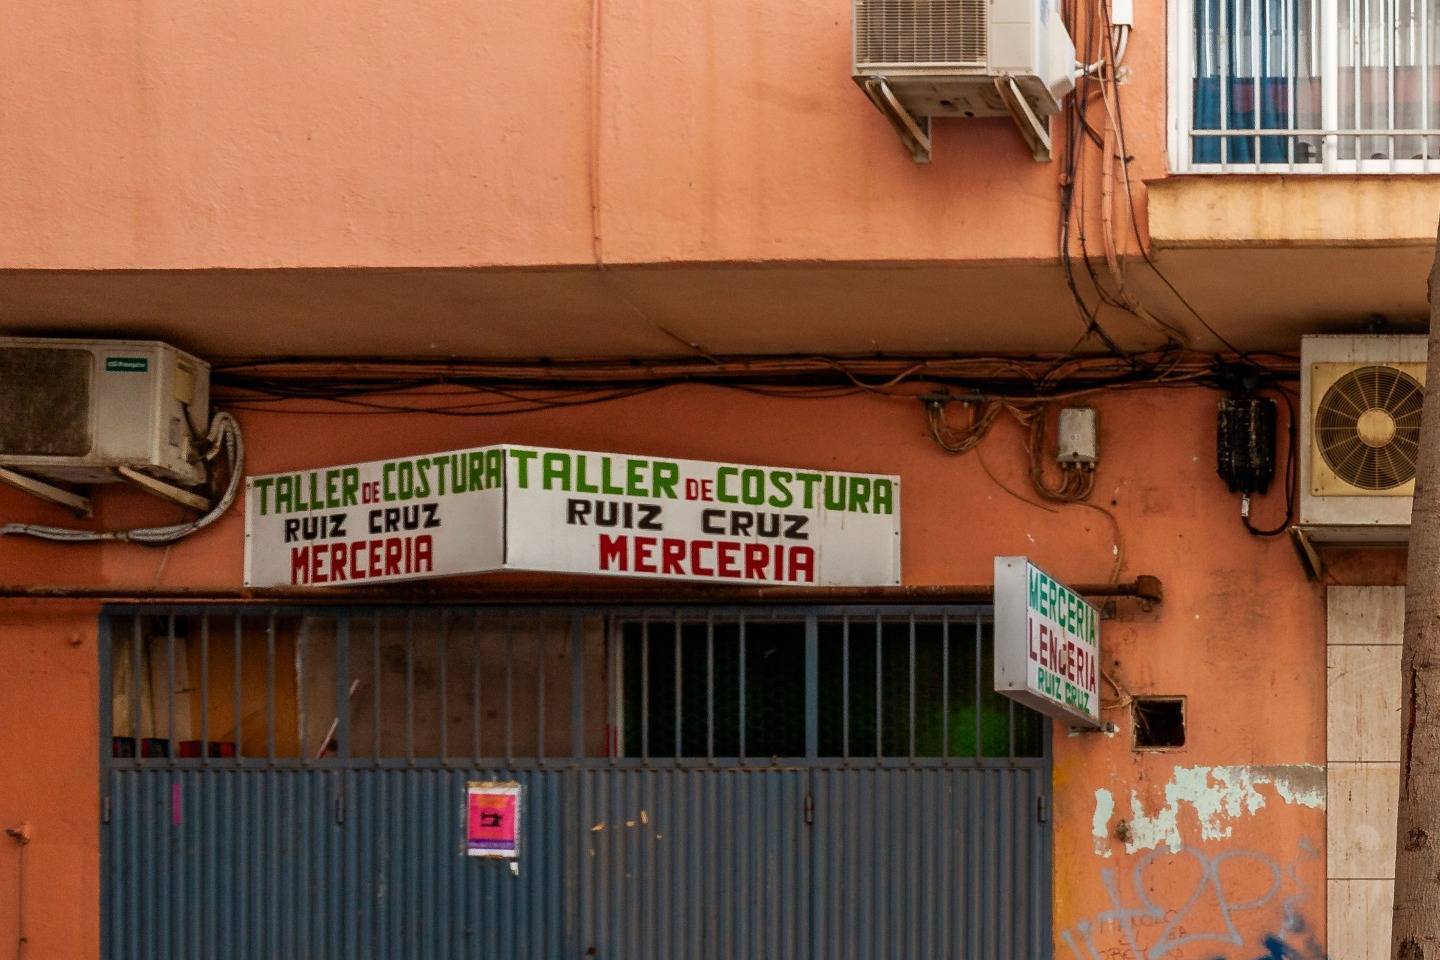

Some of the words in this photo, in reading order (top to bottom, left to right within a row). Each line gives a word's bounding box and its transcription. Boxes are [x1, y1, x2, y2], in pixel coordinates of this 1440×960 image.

[254, 467, 359, 515] TALLER
[362, 481, 379, 504] DE
[383, 449, 502, 502] COSTURA
[510, 449, 679, 499] TALLER
[685, 478, 713, 501] DE
[717, 466, 893, 515] COSTURA
[284, 513, 347, 543] RUIZ
[369, 503, 441, 534] CRUZ
[566, 498, 663, 531] RUIZ
[702, 508, 808, 540] CRUZ
[291, 534, 433, 586] MERCERIA
[599, 533, 814, 582] MERCERIA
[1029, 566, 1096, 648] MERCERIA
[1029, 617, 1096, 694] LENCERIA
[1038, 667, 1062, 701] RUIZ
[1065, 682, 1090, 714] CRUZ
